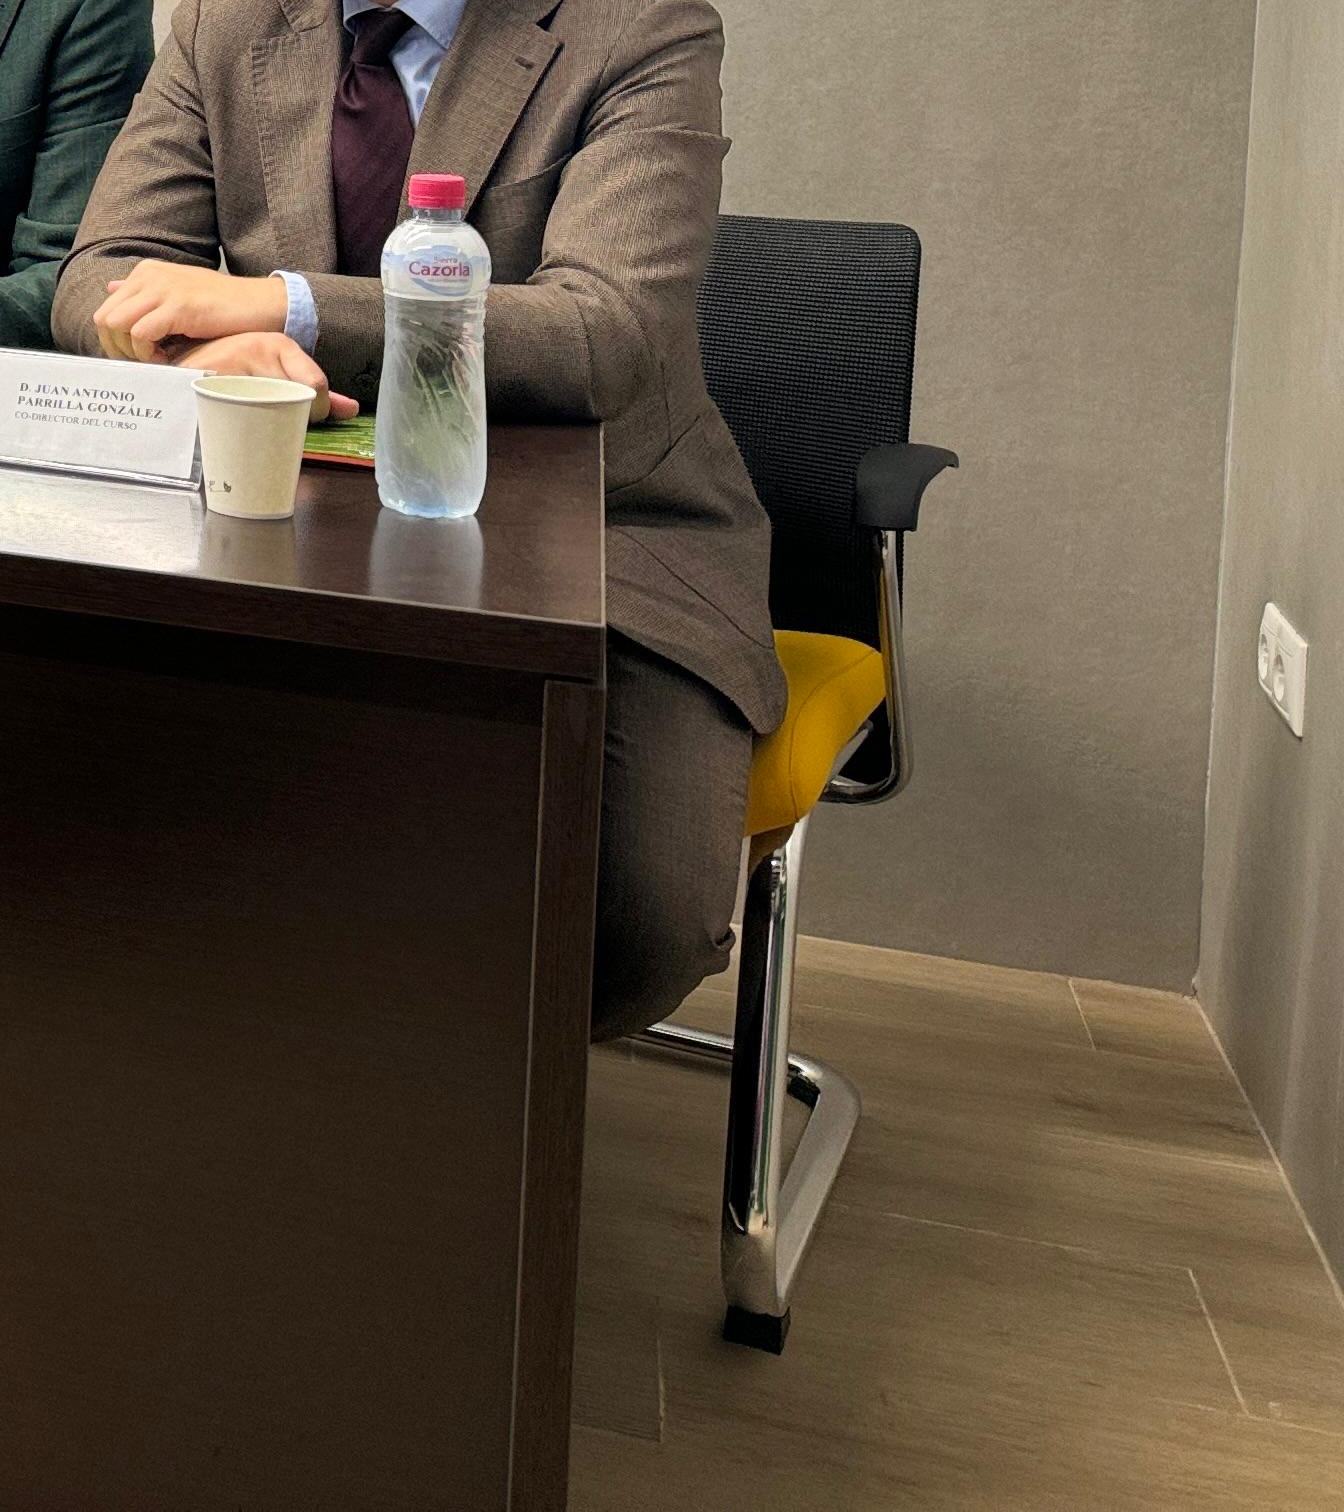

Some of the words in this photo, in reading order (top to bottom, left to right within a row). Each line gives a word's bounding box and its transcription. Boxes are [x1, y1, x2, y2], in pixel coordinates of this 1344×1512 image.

[409, 261, 470, 276] Cazorla
[20, 382, 30, 392] D.
[34, 384, 70, 396] JUAN
[73, 388, 135, 402] ANTONIO
[17, 395, 84, 411] PARRILLA
[88, 400, 162, 420] GONZÁLEZ
[15, 410, 80, 426] CO-DIRECTOR
[81, 416, 101, 426] DEL
[104, 419, 138, 431] CURSO
